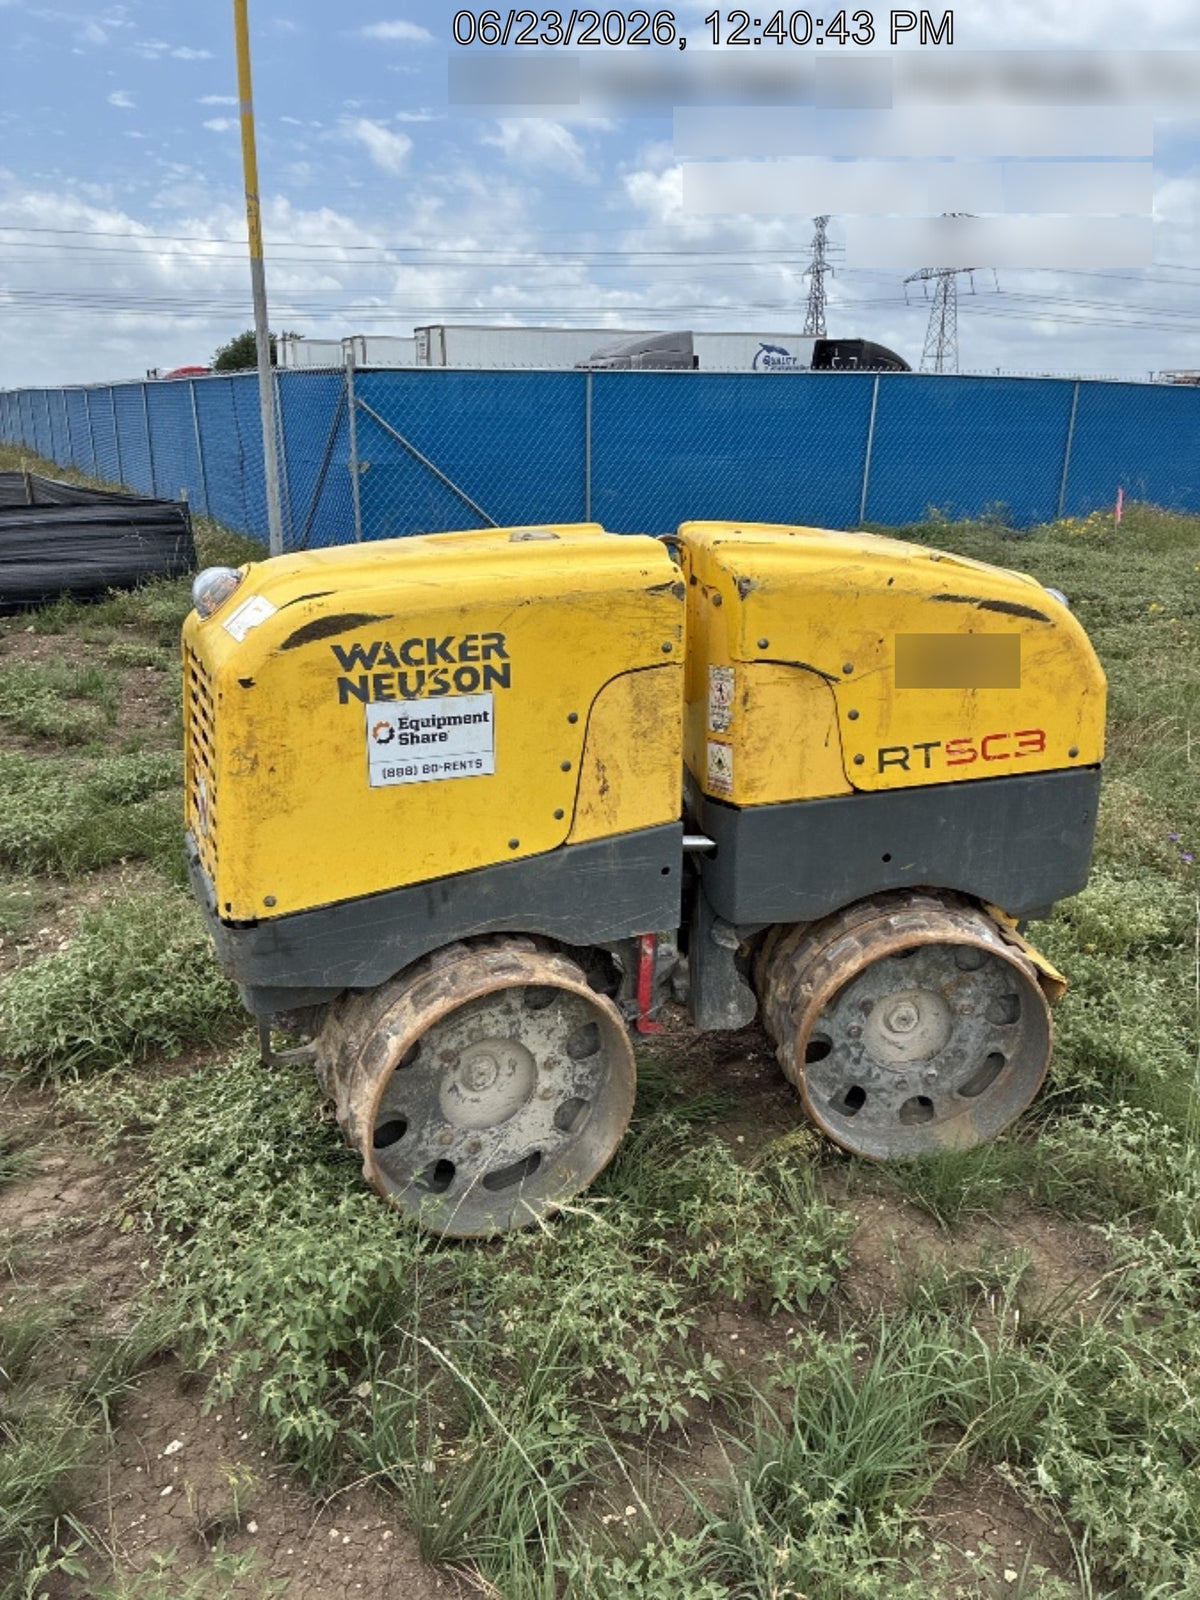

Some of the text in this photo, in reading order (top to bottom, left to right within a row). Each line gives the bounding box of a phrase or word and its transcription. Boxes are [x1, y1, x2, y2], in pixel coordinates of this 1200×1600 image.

[330, 632, 511, 672] WACKER
[337, 663, 511, 705] NEUSON
[398, 710, 490, 731] Equipment
[398, 731, 449, 746] Share
[382, 758, 483, 779] (888) 80-RENTS
